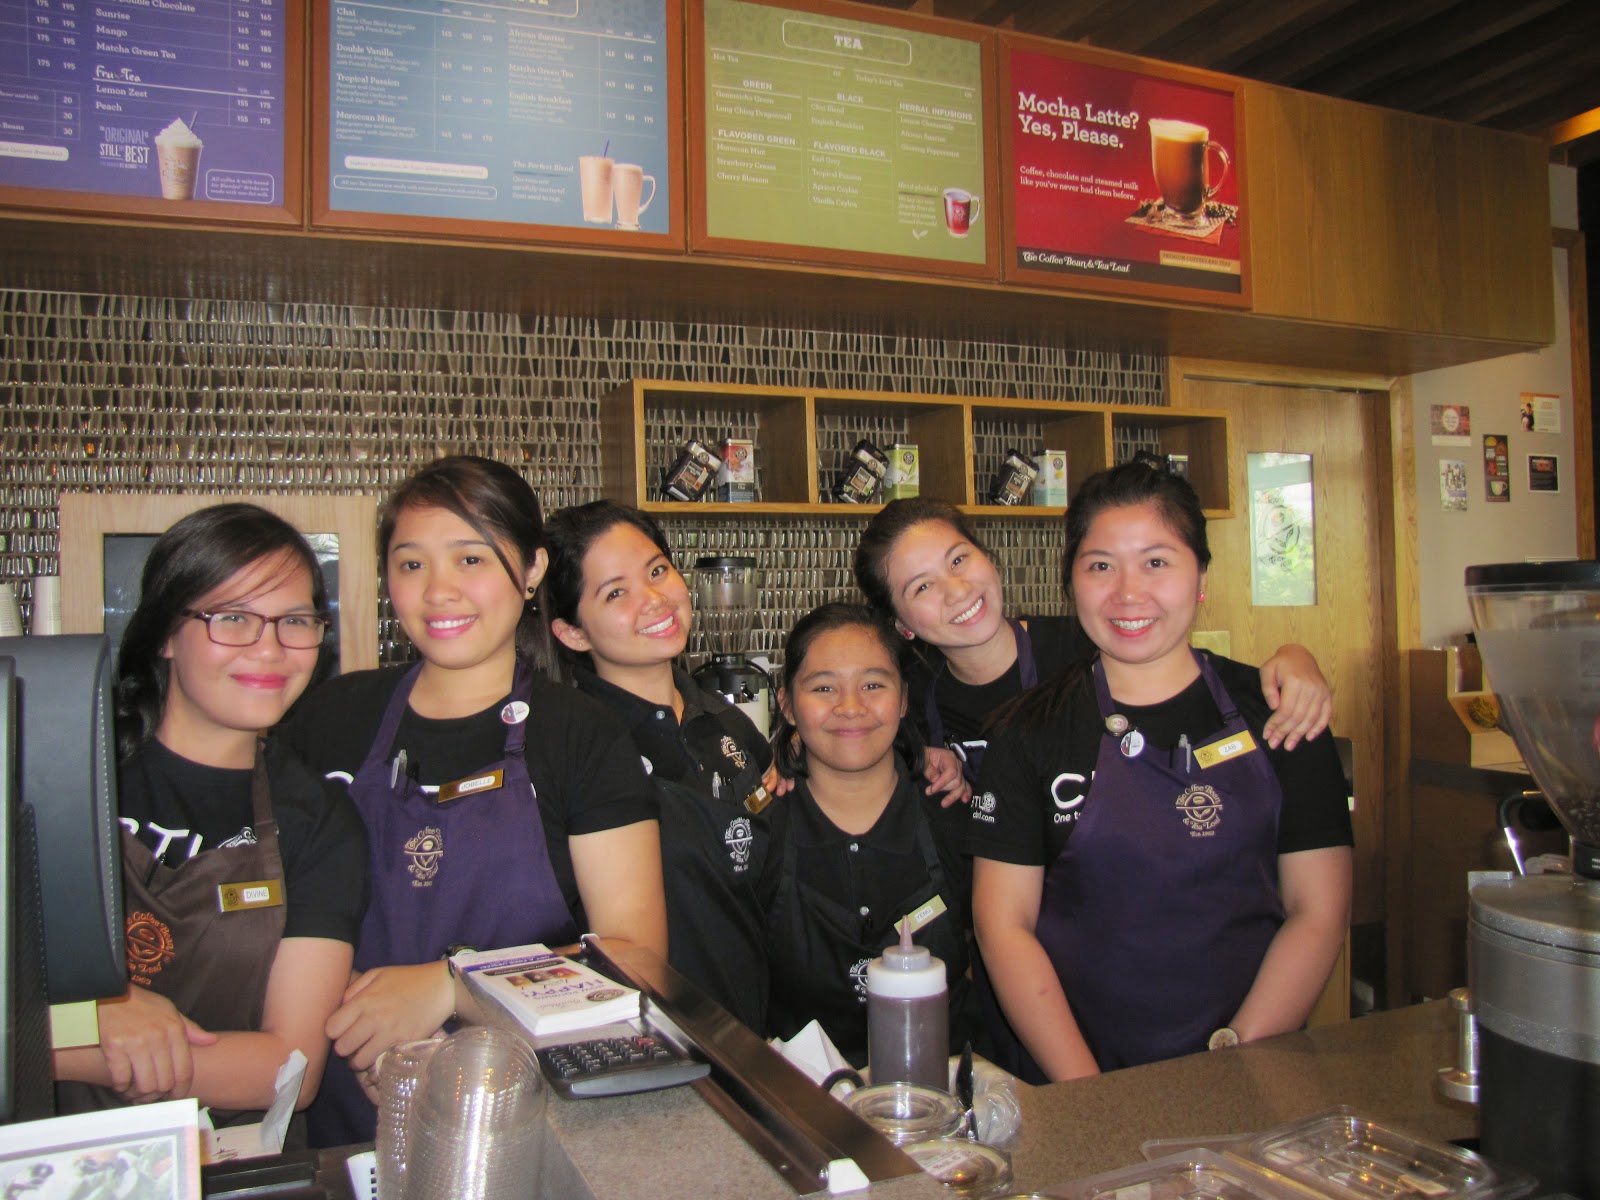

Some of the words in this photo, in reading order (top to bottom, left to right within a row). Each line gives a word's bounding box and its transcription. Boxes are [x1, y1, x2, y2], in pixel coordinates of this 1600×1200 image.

[150, 0, 196, 12] Chocolate
[36, 16, 50, 24] 175
[95, 8, 131, 20] Sunrise
[95, 25, 128, 37] Mango
[36, 33, 50, 42] 175
[63, 37, 76, 46] 195
[833, 34, 863, 50] TEA
[96, 42, 130, 53] Matcha
[131, 46, 159, 57] Green
[160, 50, 177, 59] Tea
[37, 58, 51, 68] 175
[63, 62, 76, 71] 195
[95, 85, 127, 96] Lemon
[128, 88, 148, 98] Zest
[742, 80, 773, 91] GREEN
[836, 92, 864, 104] BLACK
[95, 101, 122, 112] Peach
[899, 102, 929, 114] HERBAL
[931, 107, 973, 121] INFUSIONS
[1018, 91, 1081, 120] Mocha
[1085, 103, 1139, 130] Latte?
[104, 126, 146, 145] ORIGINAL
[718, 128, 764, 141] FLAVORED
[766, 135, 796, 146] GREEN
[1018, 114, 1057, 141] Yes,
[1061, 120, 1124, 149] Please.
[100, 143, 122, 157] STILL
[125, 144, 150, 164] BEST
[813, 140, 857, 153] FLAVORED
[859, 146, 886, 158] BLACK
[716, 171, 741, 182] Cherry
[741, 174, 769, 184] Blossom
[1020, 165, 1045, 178] Coffee,
[1046, 169, 1079, 182] chocolate
[1080, 175, 1093, 184] and
[1094, 177, 1122, 188] steamed
[1123, 182, 1139, 191] milk
[1020, 176, 1034, 186] like
[1035, 179, 1058, 190] you've
[1059, 184, 1079, 193] never
[1080, 184, 1093, 195] had
[1094, 186, 1112, 197] them
[1112, 188, 1136, 201] before.
[1022, 251, 1038, 262] The
[1038, 253, 1064, 265] Coffee
[1064, 255, 1087, 269] Bean
[1087, 259, 1095, 269] &
[1095, 259, 1109, 270] Tea
[1109, 261, 1131, 273] Leaf
[1184, 784, 1205, 795] Cffee
[1053, 812, 1071, 824] One
[246, 889, 269, 899] DIVINE
